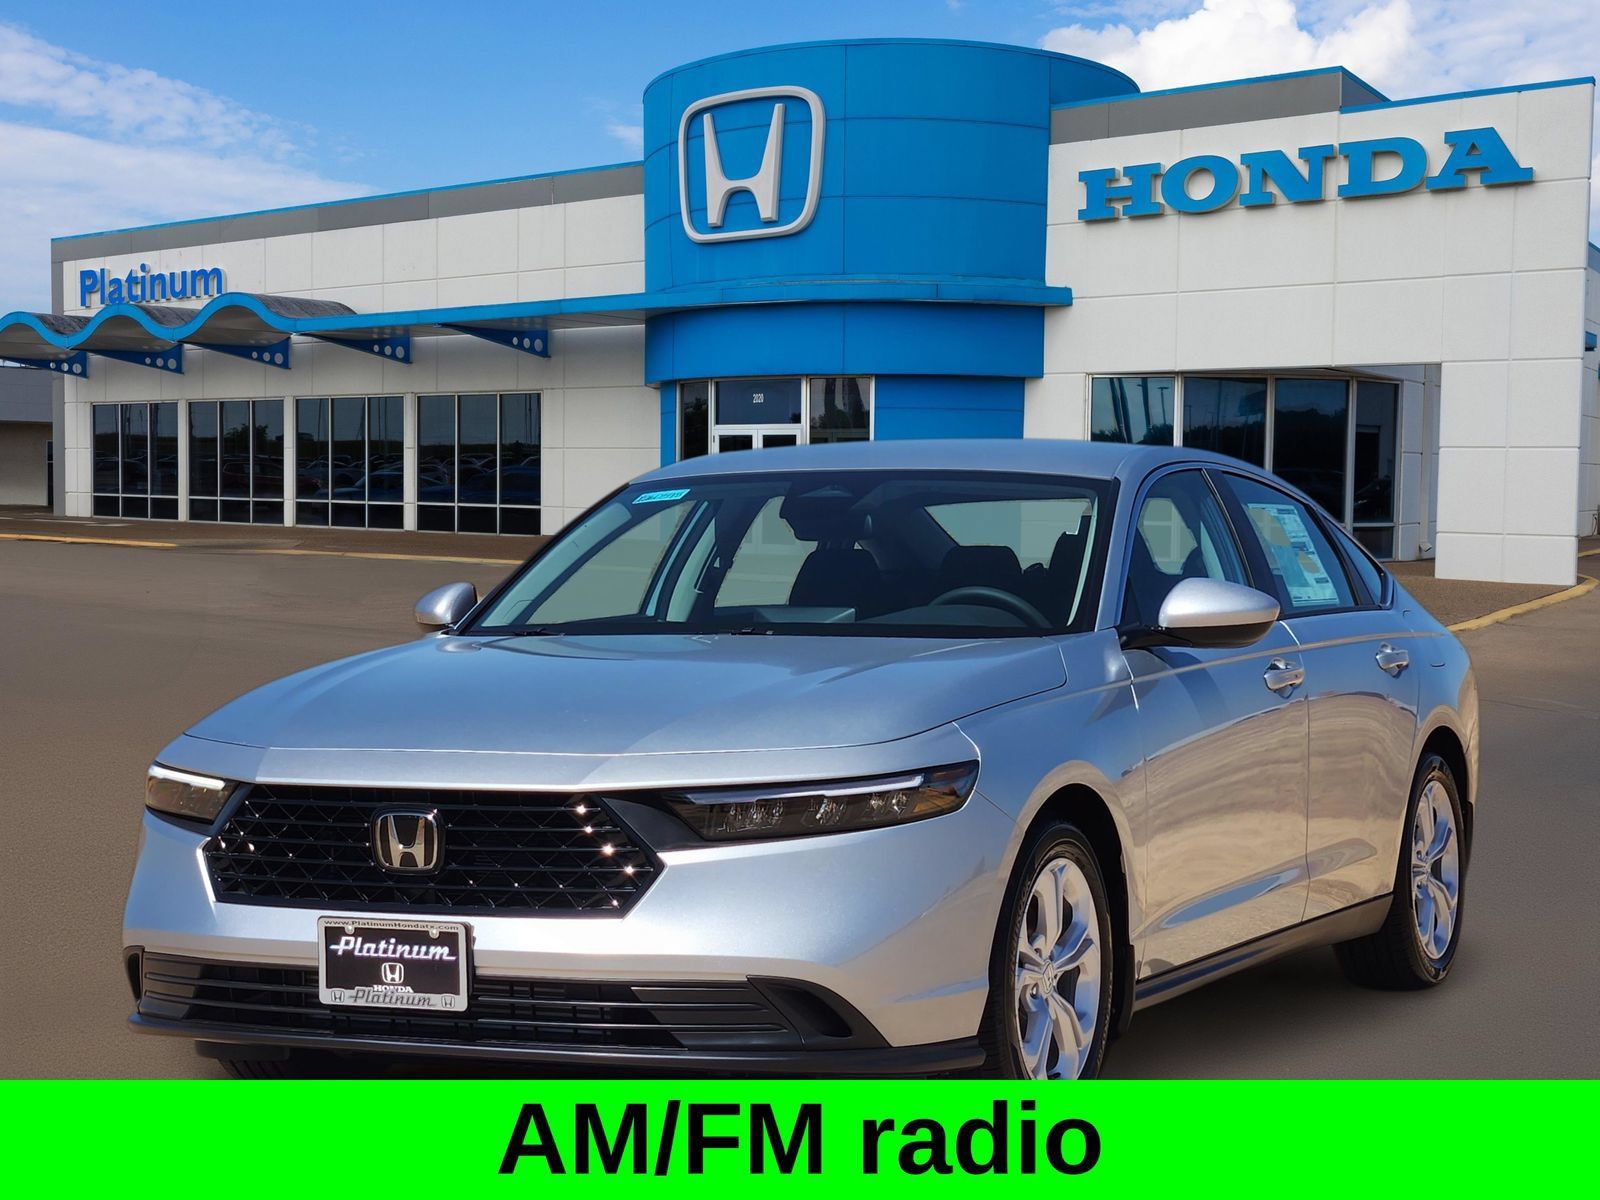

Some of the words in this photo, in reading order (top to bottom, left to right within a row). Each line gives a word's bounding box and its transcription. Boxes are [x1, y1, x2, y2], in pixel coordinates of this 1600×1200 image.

[1078, 127, 1534, 222] HONDA
[80, 263, 225, 307] Platinum
[329, 936, 457, 960] Platinum
[348, 988, 437, 1007] Platinum
[372, 984, 414, 993] HONDA
